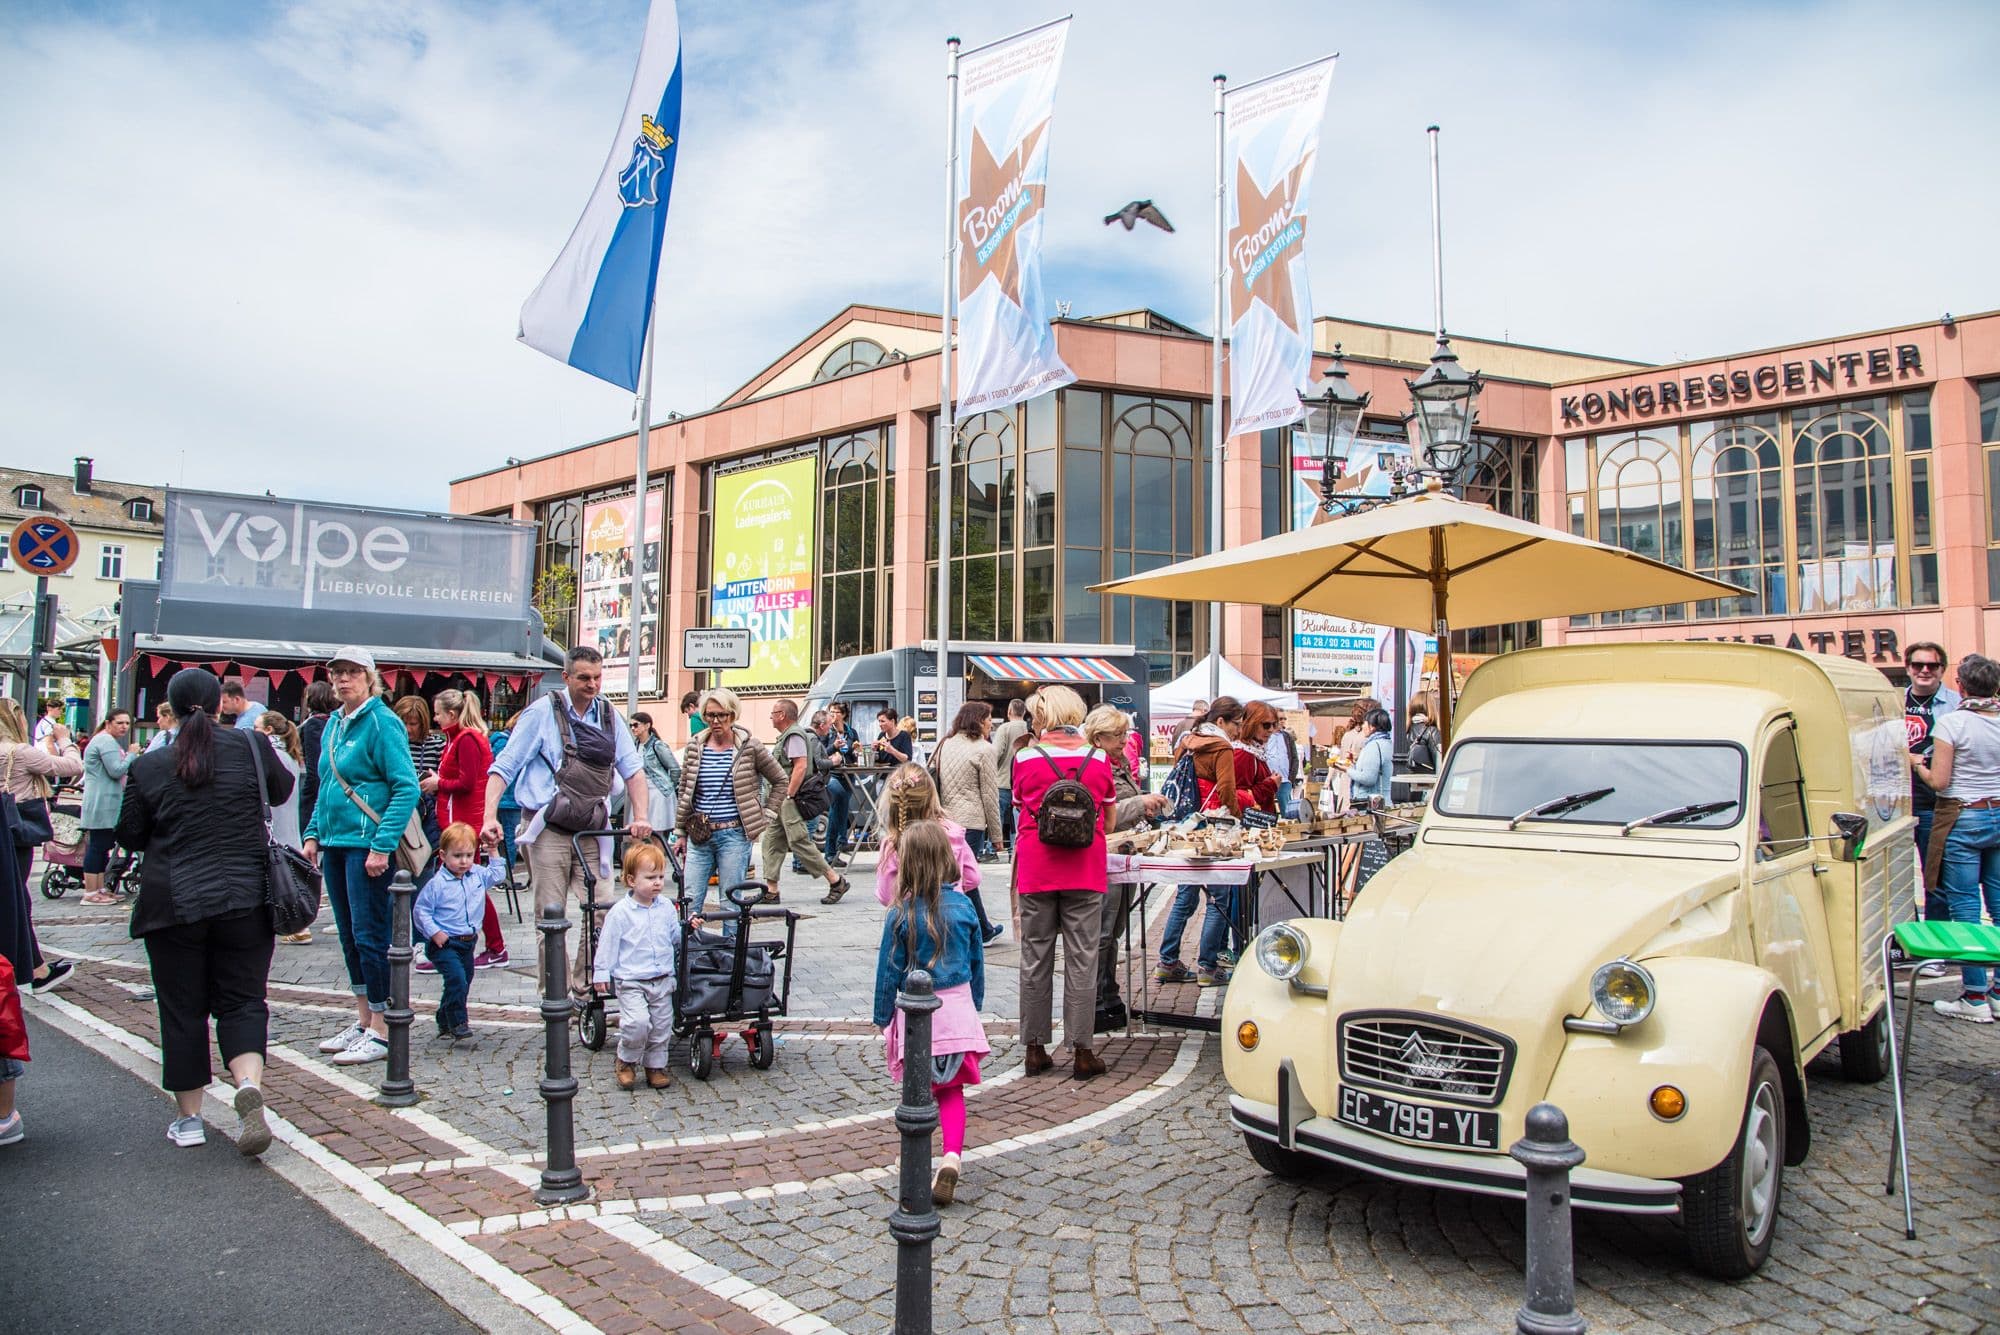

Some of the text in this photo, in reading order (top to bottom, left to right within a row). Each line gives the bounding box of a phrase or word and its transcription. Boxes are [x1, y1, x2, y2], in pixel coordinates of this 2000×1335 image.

[963, 140, 1023, 248] Boom!
[1233, 175, 1292, 274] Boom!
[978, 230, 1002, 264] DESIGN
[991, 389, 1009, 400] FOOD
[1041, 367, 1067, 383] DESIGN
[1560, 344, 1922, 420] KONGRESSCENTER
[1266, 409, 1281, 420] FOOD
[735, 506, 792, 529] Ladengalerie
[319, 579, 513, 603] LIEBEVOLLE LECKEREIEN
[727, 592, 795, 614] UND ALLES
[1302, 618, 1347, 633] Kurhaus
[1350, 622, 1357, 633] &
[1301, 636, 1312, 646] SA
[1353, 639, 1375, 649] APRIL
[1342, 1087, 1491, 1147] EC-799-YL
